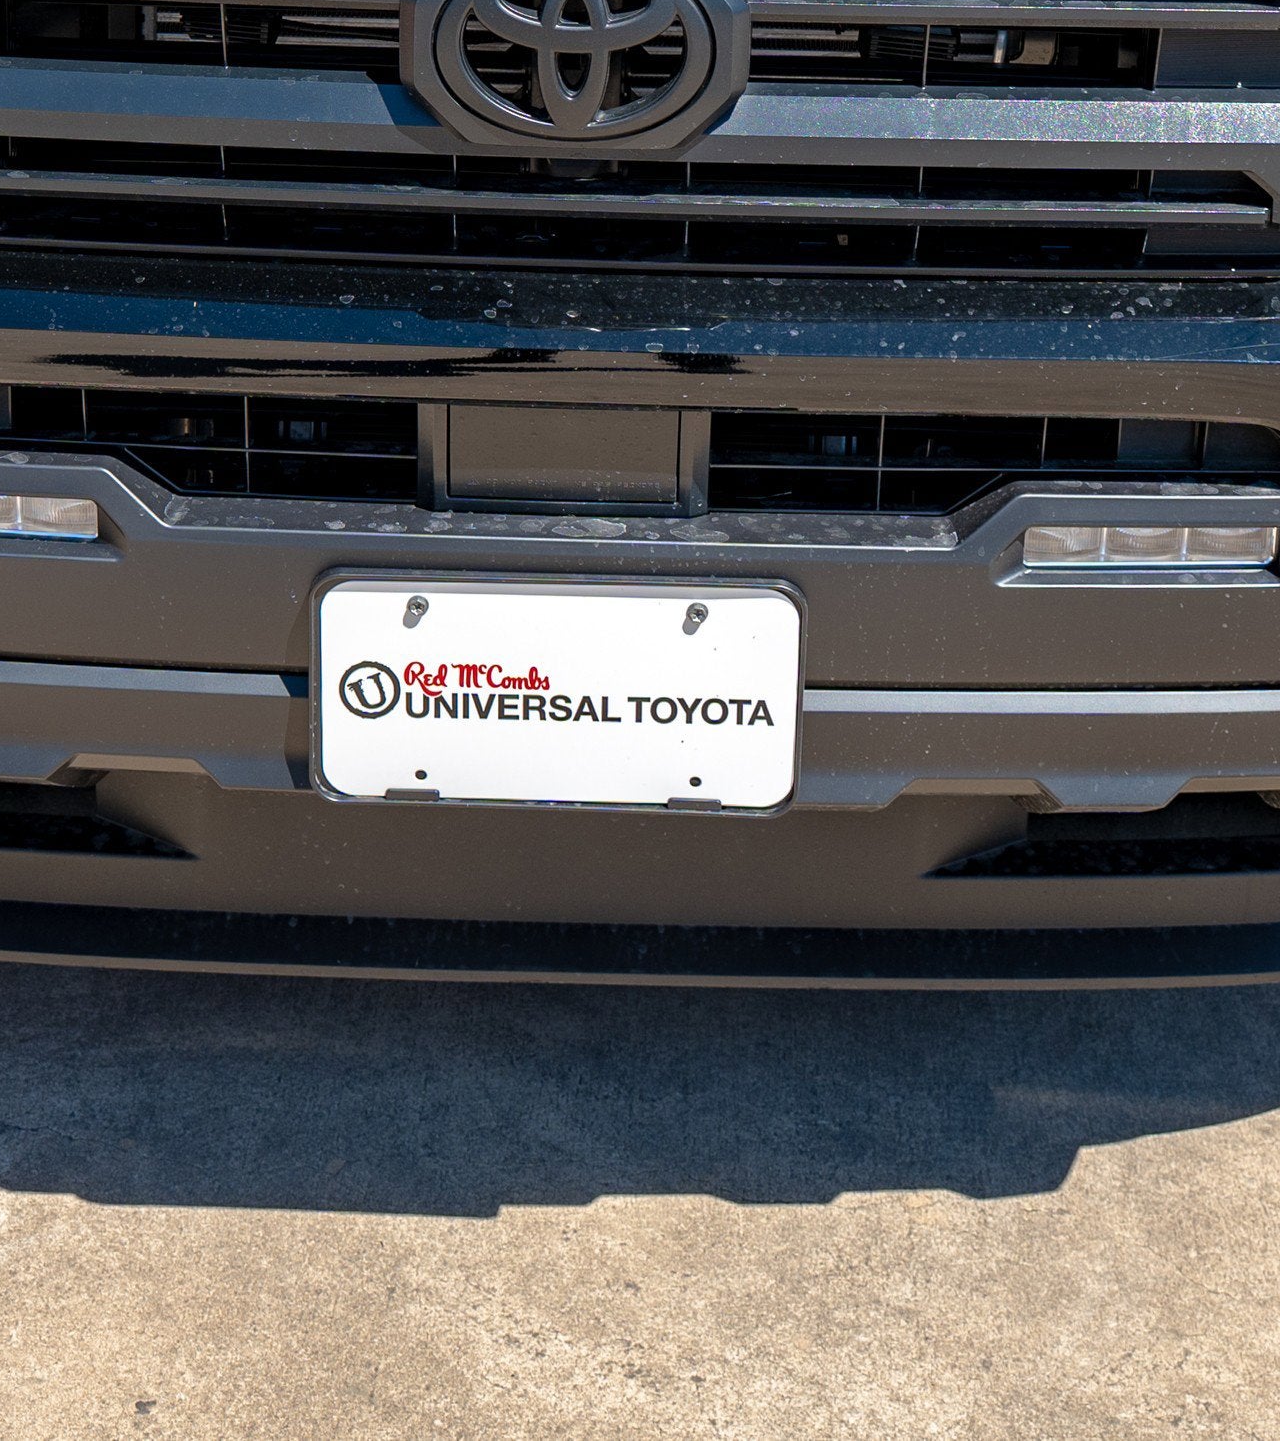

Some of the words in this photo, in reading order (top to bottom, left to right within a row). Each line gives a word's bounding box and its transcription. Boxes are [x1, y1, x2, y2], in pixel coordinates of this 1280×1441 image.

[403, 661, 448, 698] Red
[451, 662, 550, 691] McCombs
[405, 693, 622, 723] UNIVERSAL
[627, 695, 775, 727] TOYOTA
